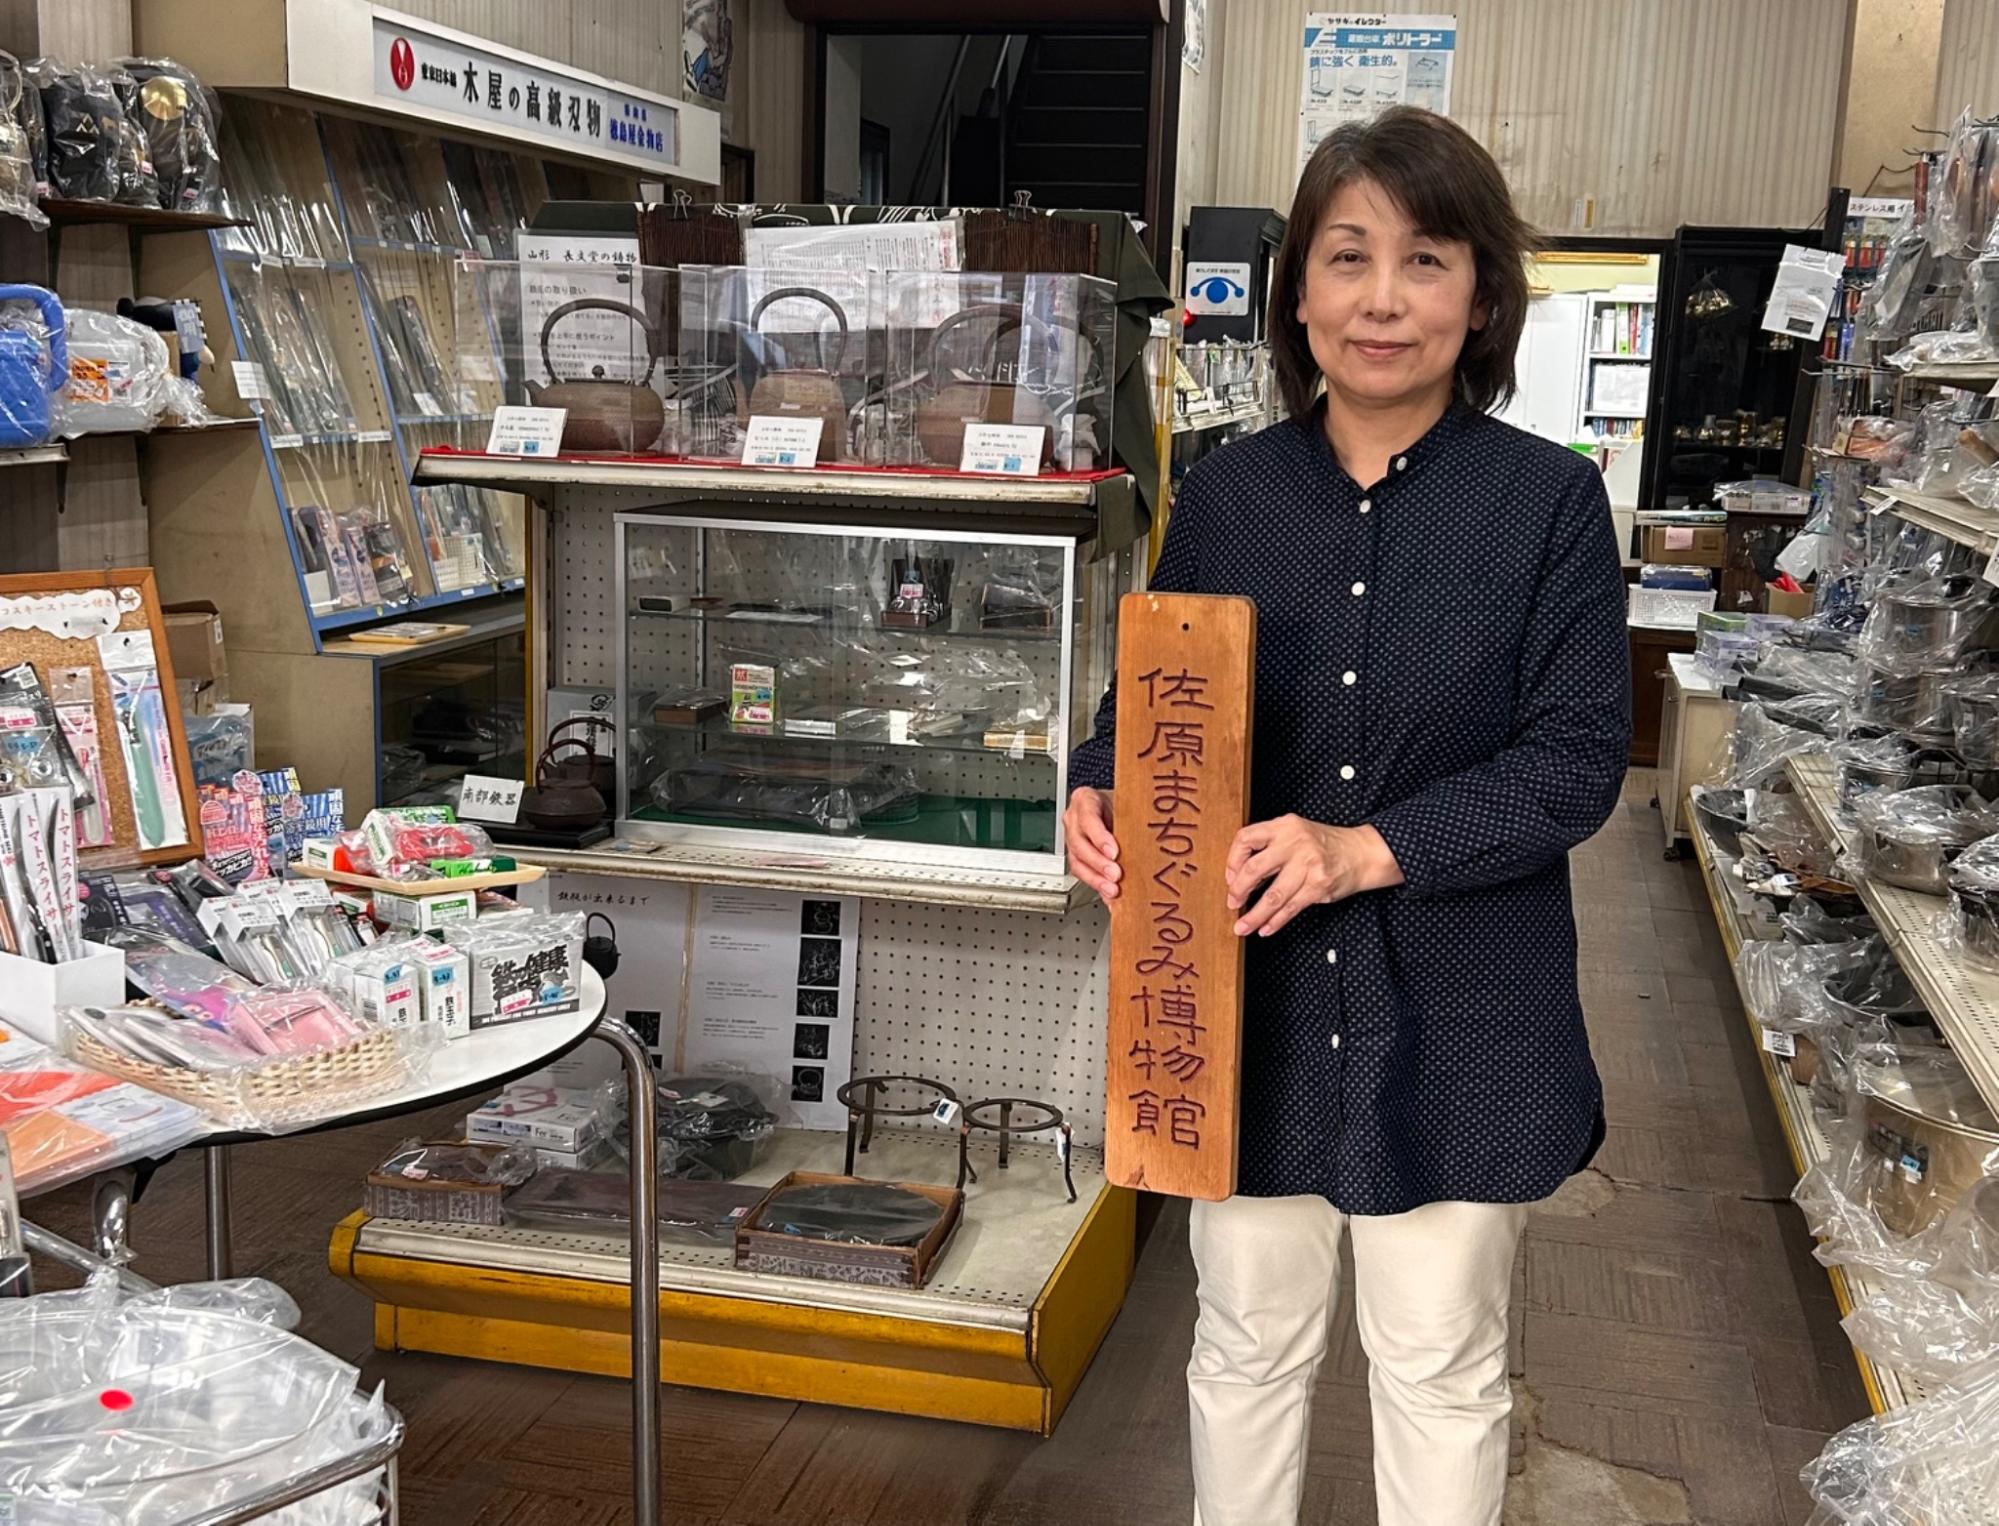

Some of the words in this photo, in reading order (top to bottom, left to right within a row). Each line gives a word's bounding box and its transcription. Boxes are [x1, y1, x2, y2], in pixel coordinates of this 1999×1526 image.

[27, 814, 60, 937] トマトスライサー
[58, 807, 74, 931] トマトスライサー
[1128, 666, 1215, 1151] 佐原まちぐるみ博物館
